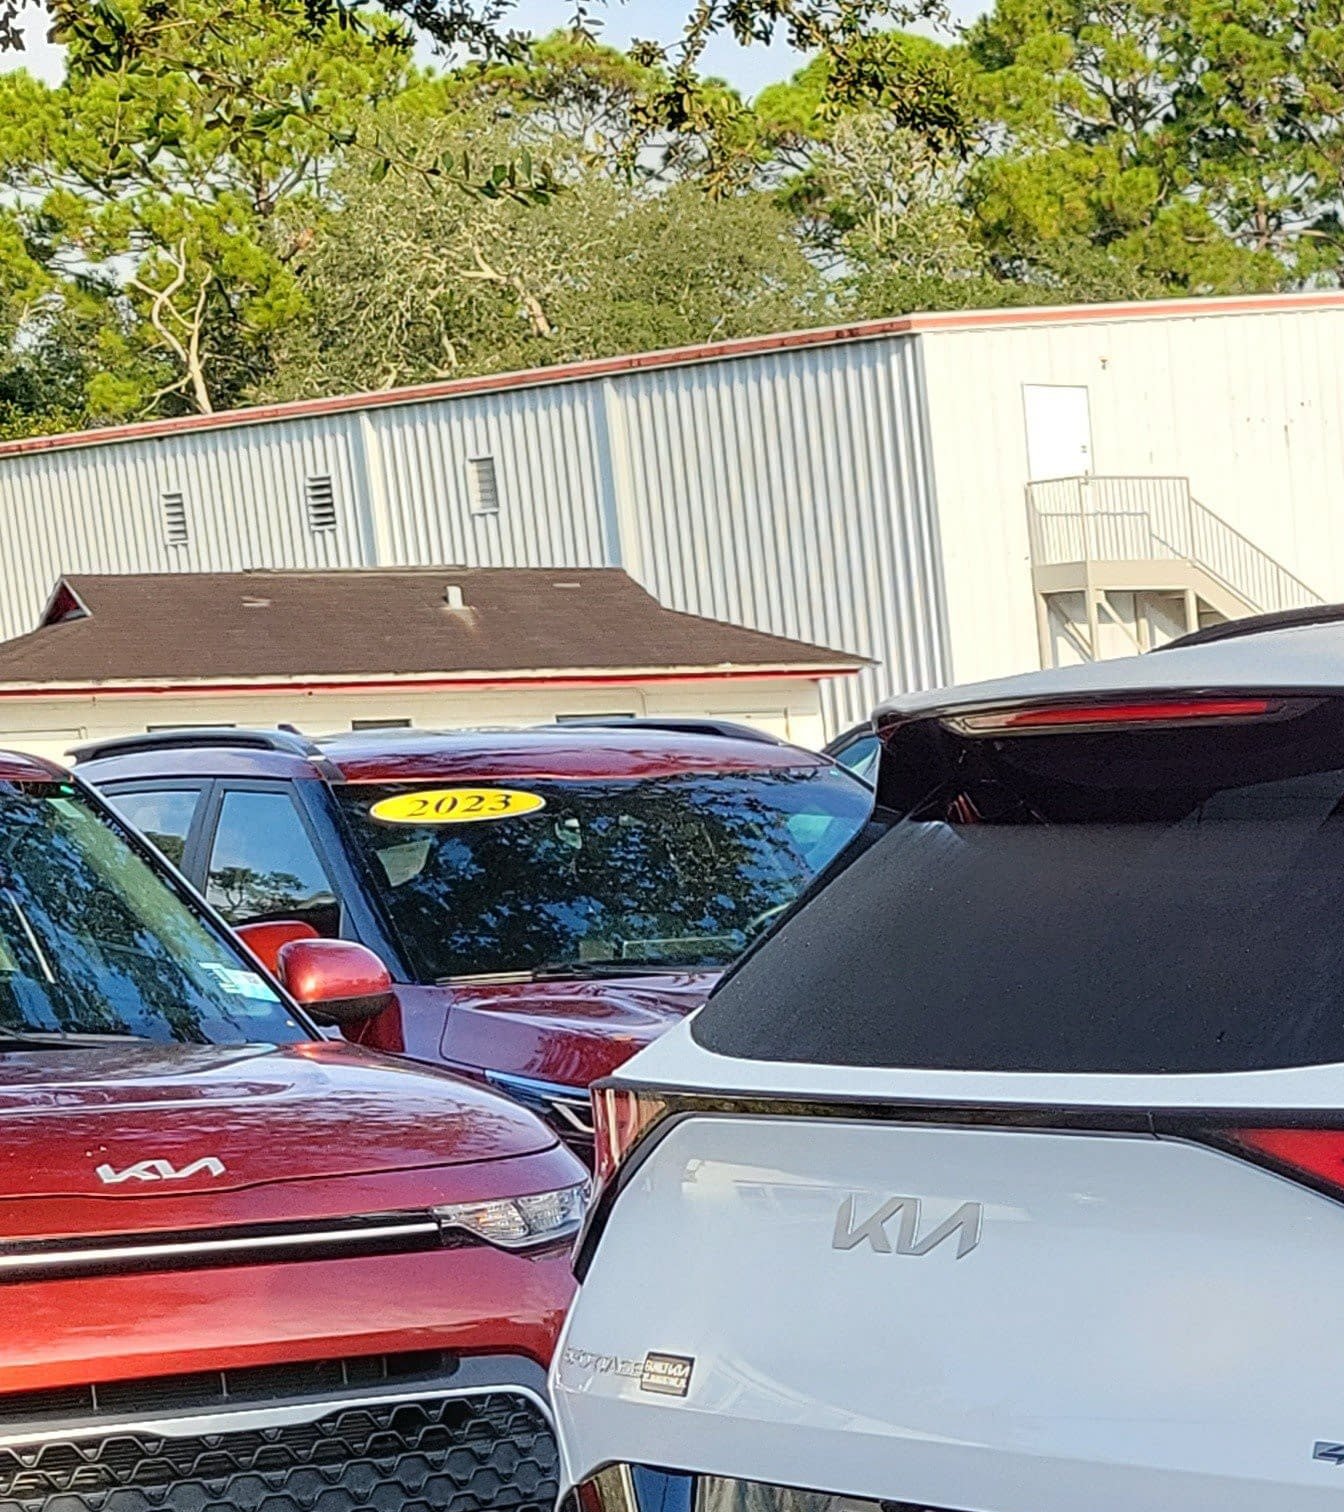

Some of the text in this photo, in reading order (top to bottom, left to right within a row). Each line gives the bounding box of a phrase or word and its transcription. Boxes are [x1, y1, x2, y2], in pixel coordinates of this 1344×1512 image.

[407, 794, 513, 817] 2023
[95, 1156, 226, 1184] KIA
[832, 1194, 984, 1260] KIA
